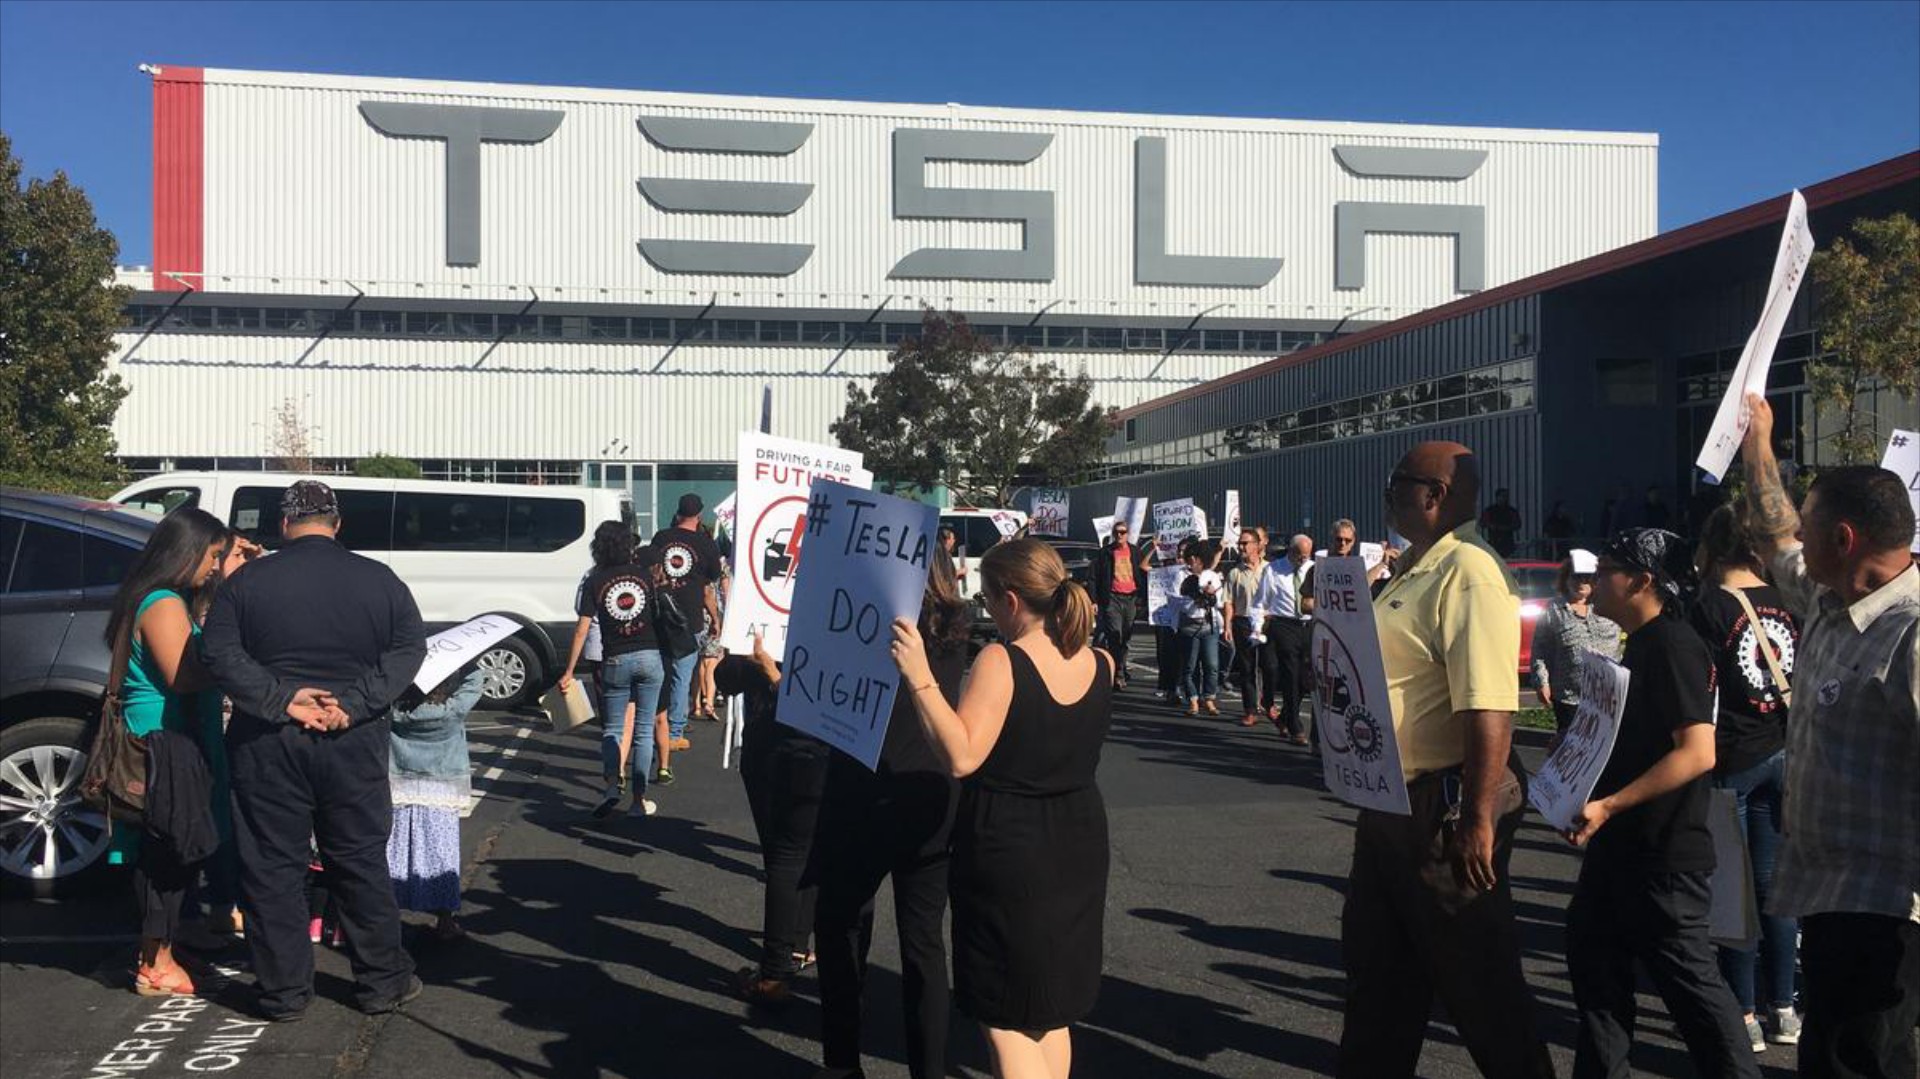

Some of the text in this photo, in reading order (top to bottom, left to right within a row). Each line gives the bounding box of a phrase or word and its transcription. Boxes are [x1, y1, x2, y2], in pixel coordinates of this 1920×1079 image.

[359, 101, 1489, 293] TESLA
[756, 447, 852, 473] DRIVING A FAIR
[1038, 506, 1058, 518] DO
[844, 499, 928, 569] TESLA
[1327, 573, 1353, 586] FAIR
[829, 588, 881, 645] DO
[1319, 588, 1357, 612] URE
[786, 645, 890, 730] RIGHT
[1335, 763, 1390, 794] TESLA
[134, 993, 208, 1032] PAR
[184, 1018, 270, 1071] ONLY
